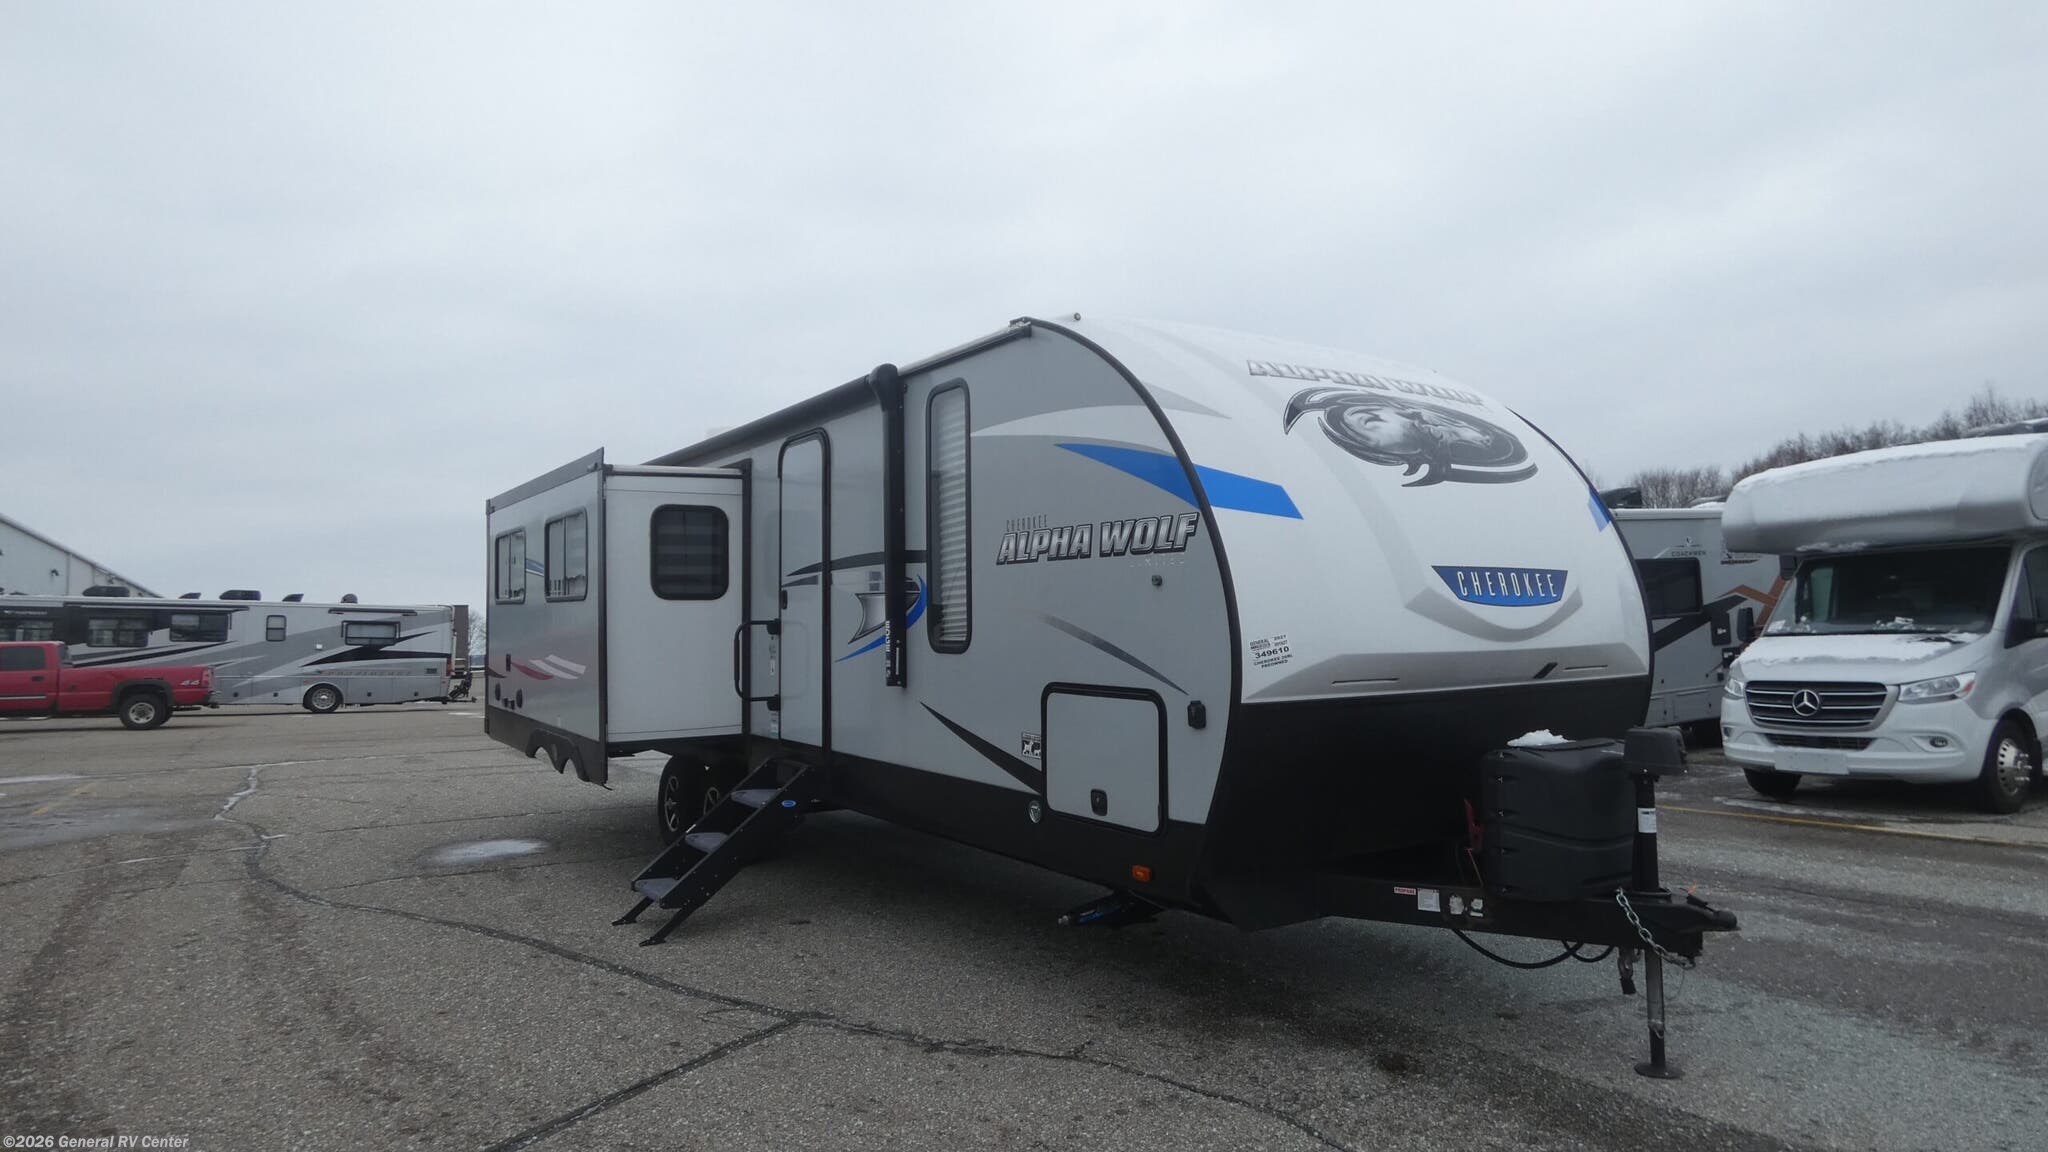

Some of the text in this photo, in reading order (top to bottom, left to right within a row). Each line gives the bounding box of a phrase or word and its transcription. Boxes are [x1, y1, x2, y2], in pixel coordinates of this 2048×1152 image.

[996, 512, 1200, 565] ALPHA WOLF
[1457, 571, 1557, 597] CHEROKEE
[1255, 646, 1290, 659] 349610
